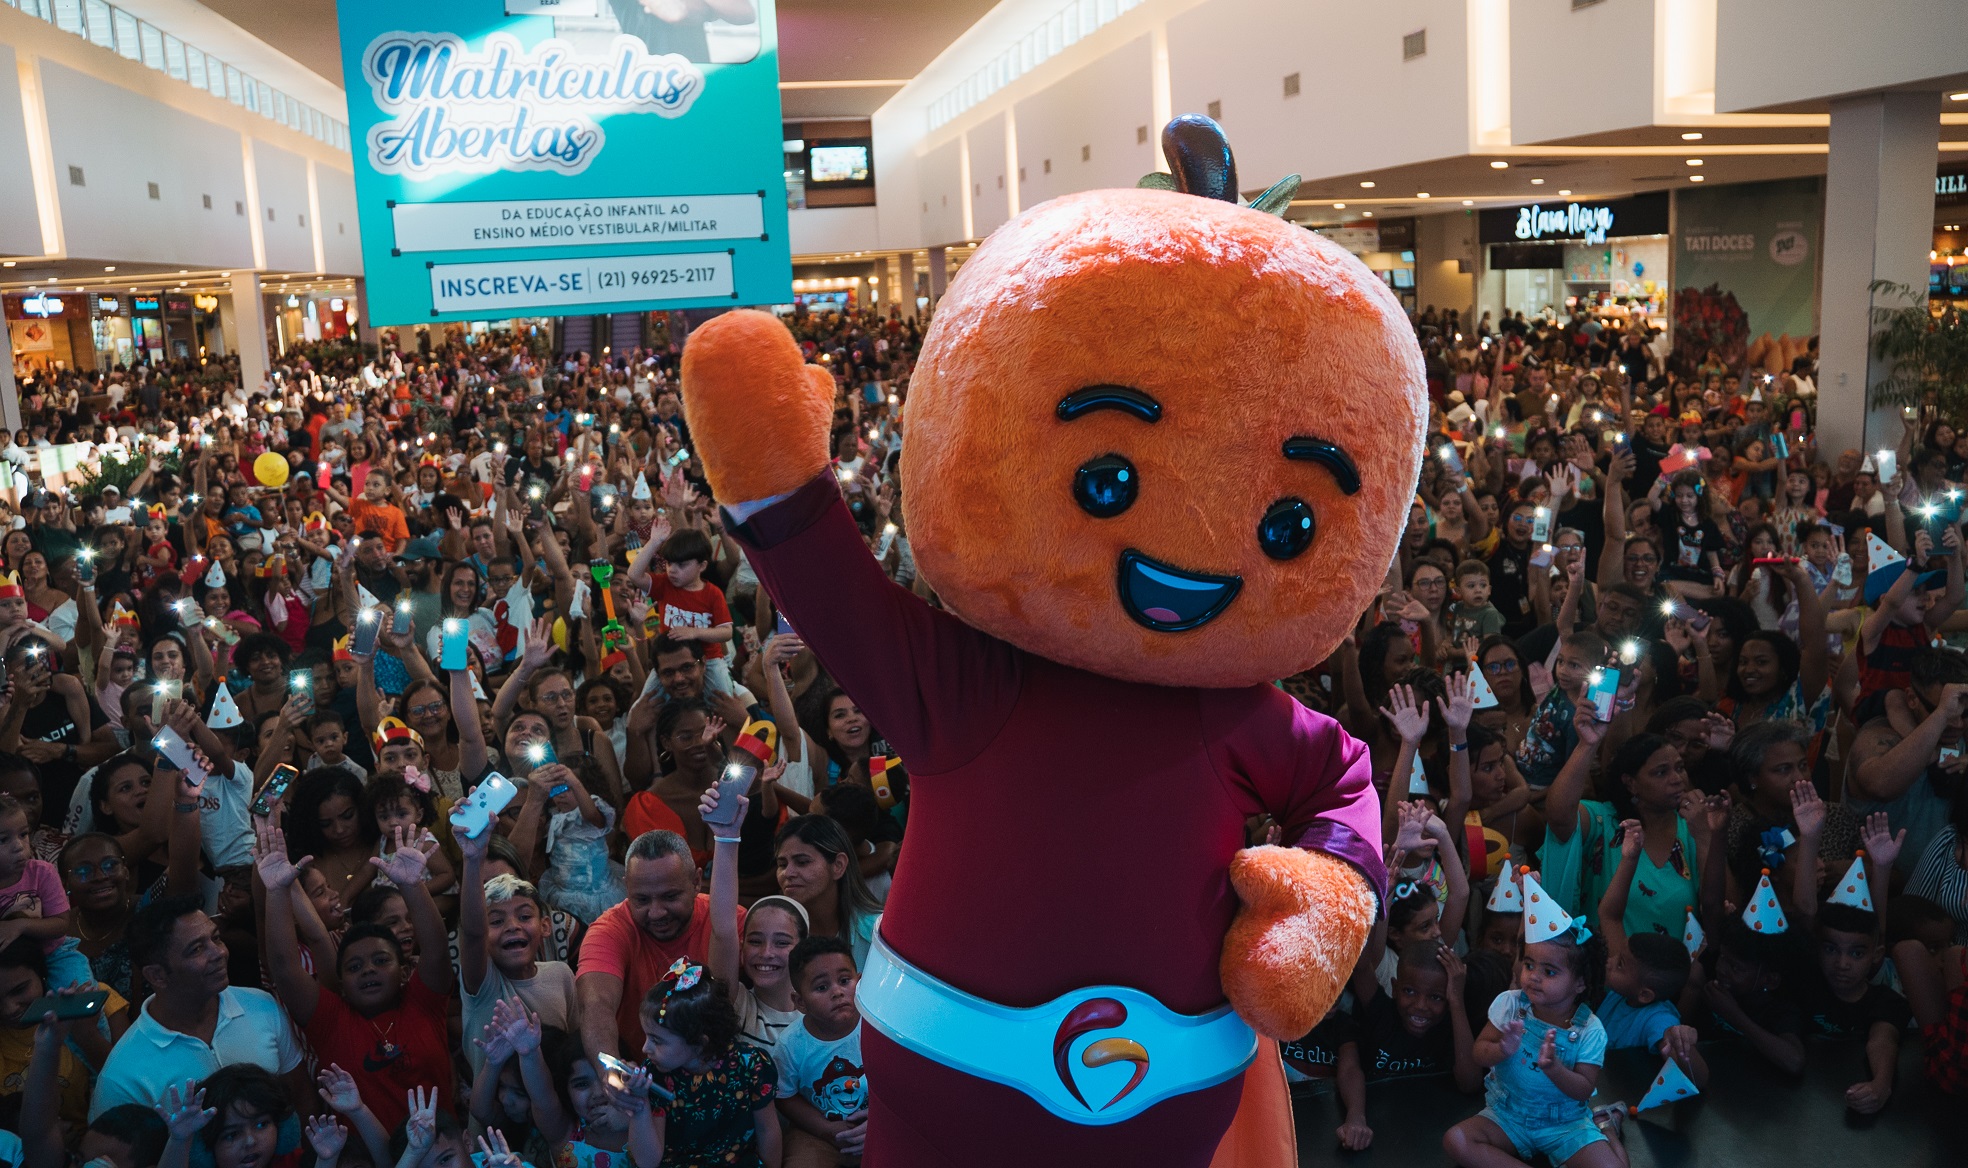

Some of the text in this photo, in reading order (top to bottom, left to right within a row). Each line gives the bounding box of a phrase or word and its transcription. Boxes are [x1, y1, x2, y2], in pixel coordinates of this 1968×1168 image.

[376, 44, 692, 105] Matrículas
[382, 107, 594, 166] Abertas
[502, 200, 690, 223] DA EDUCAÇÃO INFANTIL AO
[1568, 203, 1613, 235] Nova
[474, 219, 718, 240] ENSINO MÉDIO VESTIBULAR/MILITAR
[1685, 234, 1755, 251] TATI DOCES
[440, 271, 583, 298] INSCREVA-SE
[597, 266, 717, 288] (21) 96925-2117
